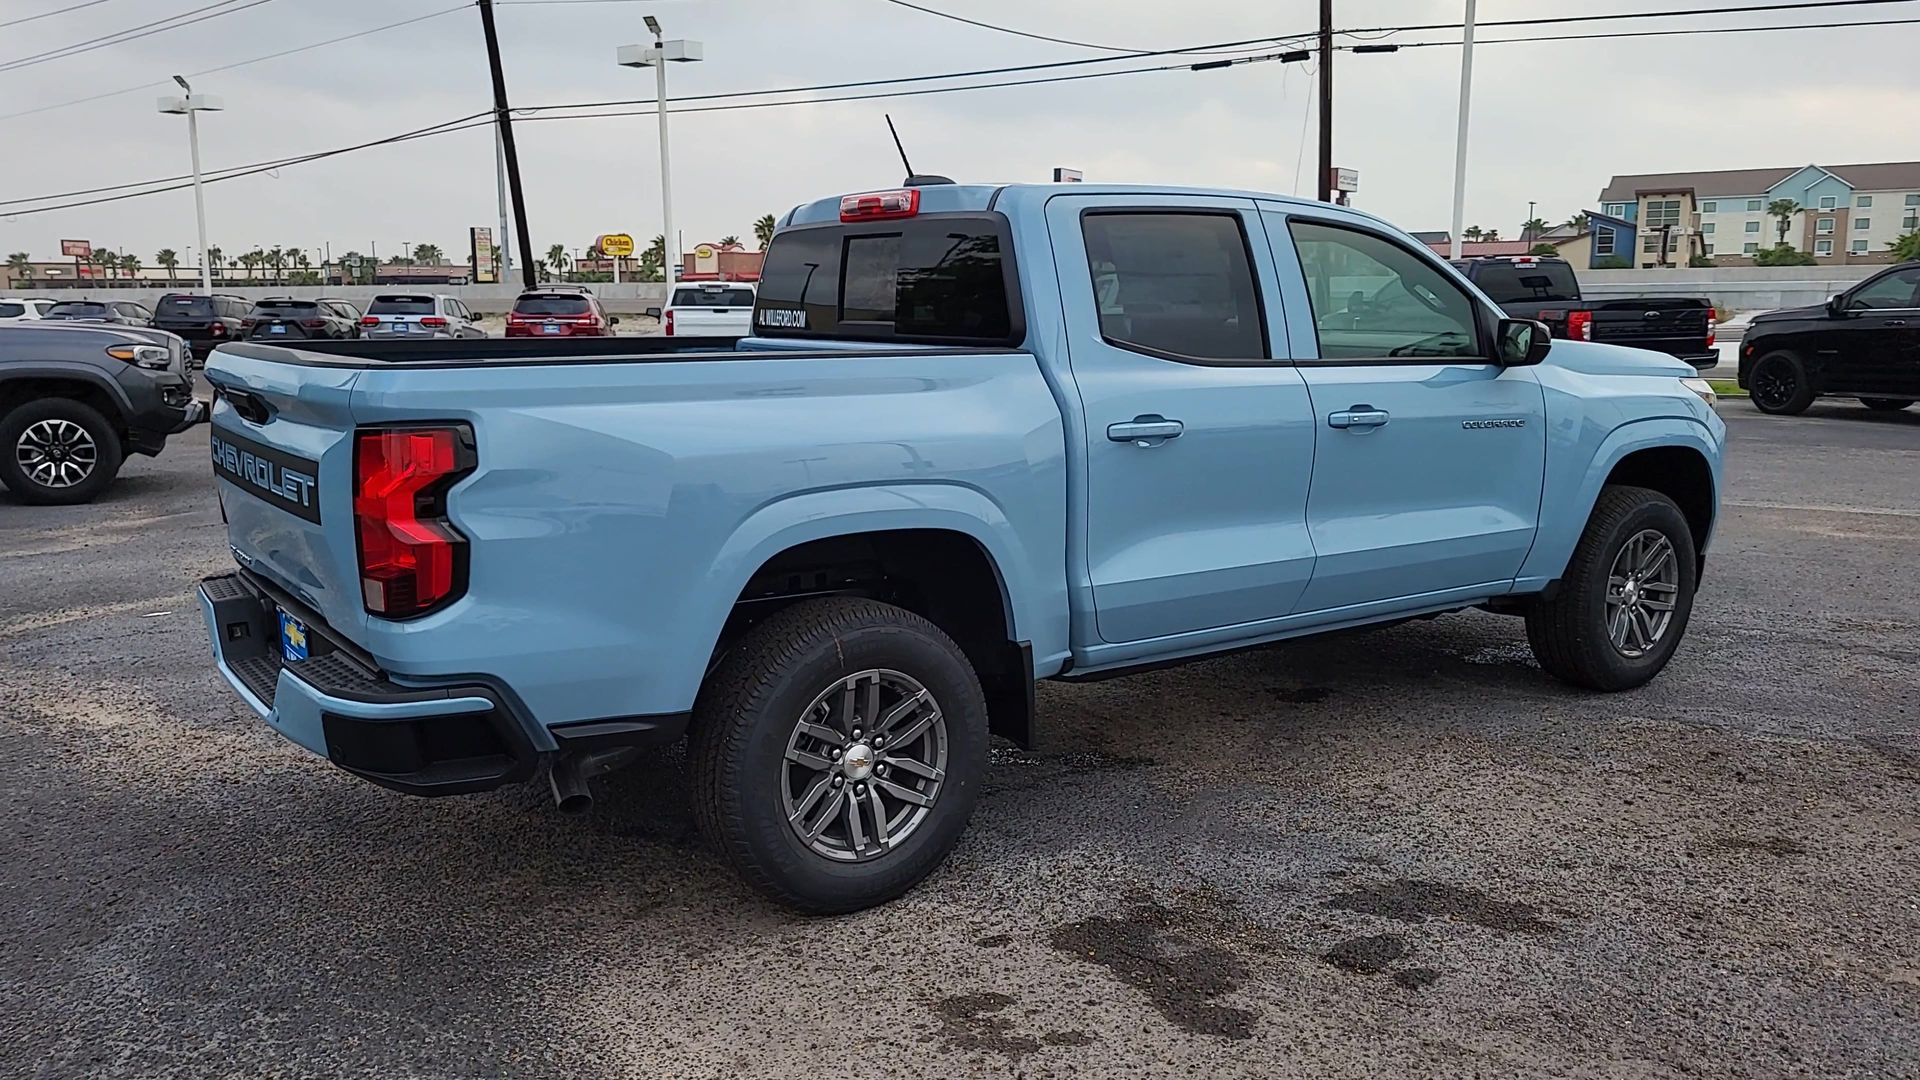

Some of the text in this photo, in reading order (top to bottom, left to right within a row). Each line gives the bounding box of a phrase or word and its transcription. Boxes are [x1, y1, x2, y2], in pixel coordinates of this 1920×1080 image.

[759, 308, 806, 328] AL WILLEFORD.COM
[1462, 419, 1525, 430] COLORADO
[211, 435, 315, 508] CHEVROLET
